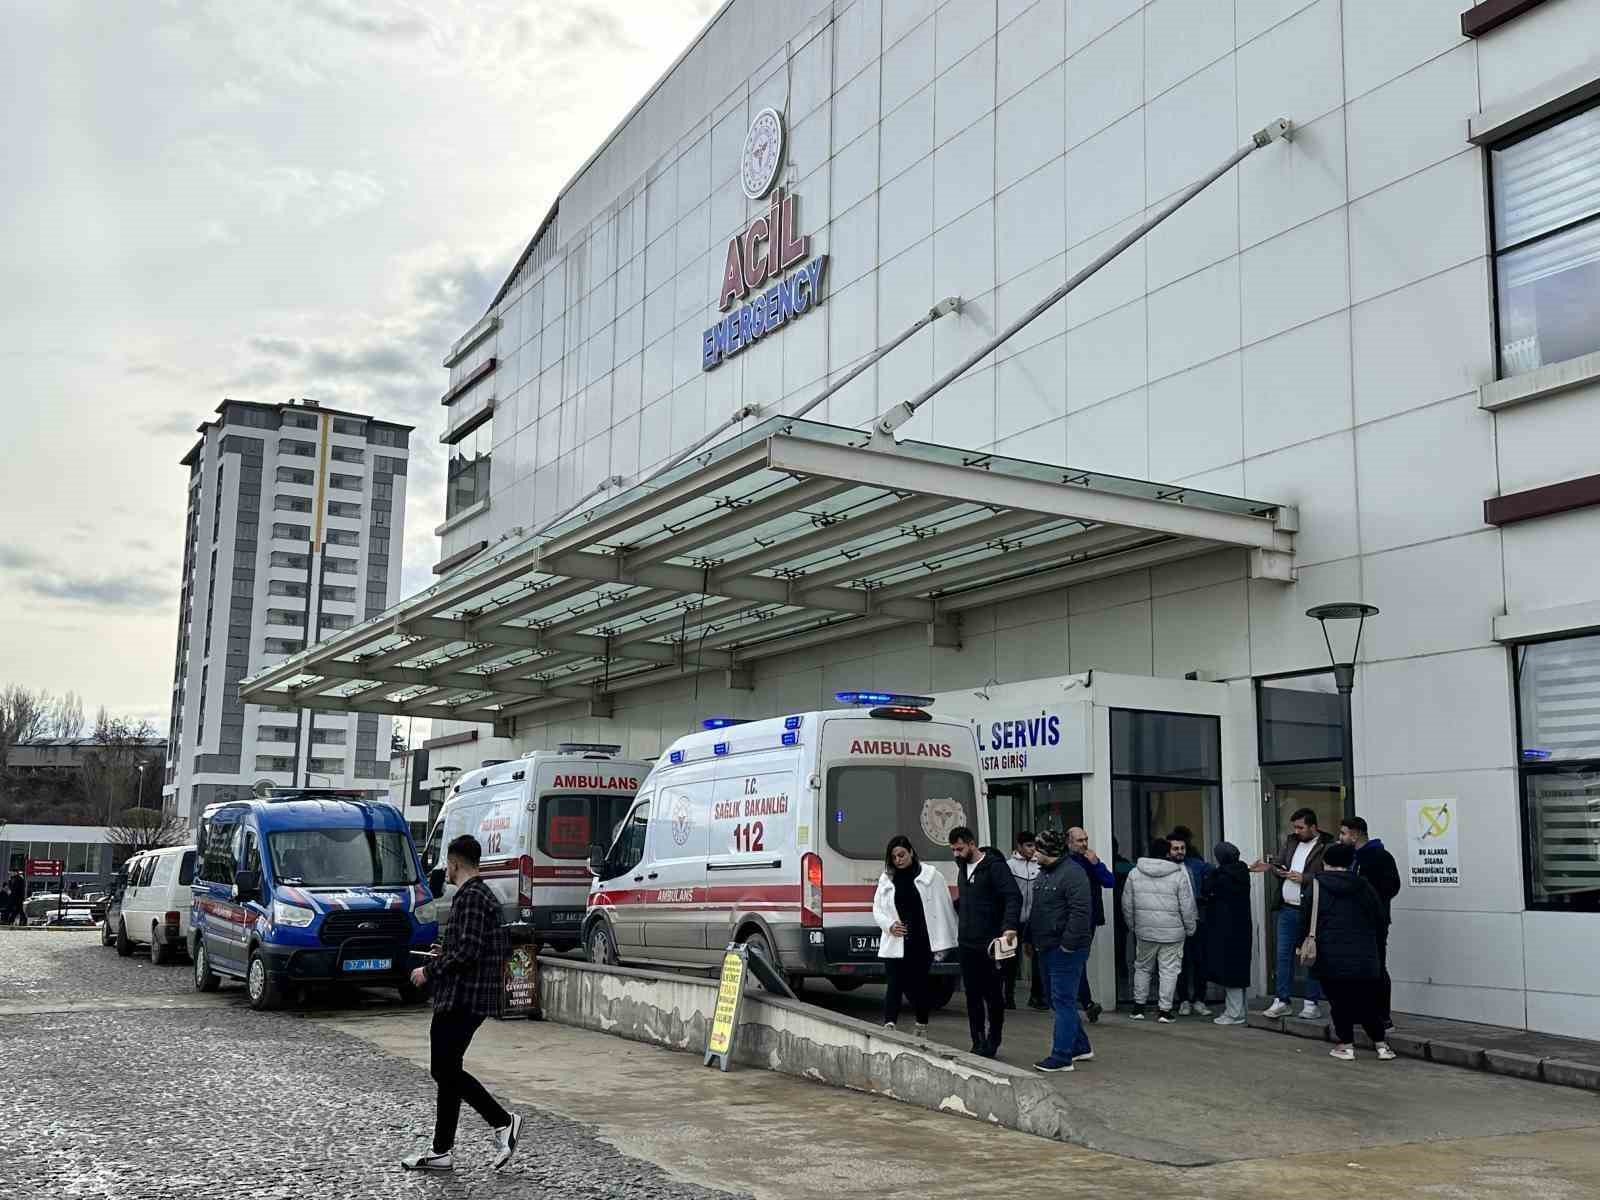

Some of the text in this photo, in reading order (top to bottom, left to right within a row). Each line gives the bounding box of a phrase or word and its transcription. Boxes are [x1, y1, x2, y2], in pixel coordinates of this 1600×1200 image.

[719, 186, 807, 312] ACİL
[703, 255, 827, 372] EMERGENCY
[992, 710, 1060, 751] SERVİS
[850, 740, 952, 758] AMBULANS
[1002, 750, 1027, 772] GİRİŞİ
[552, 775, 638, 790] AMBULANS
[744, 777, 758, 795] T.C.
[714, 792, 789, 820] SAĞLIK BAKANLIĞI
[487, 832, 502, 854] 112
[733, 821, 764, 852] 112
[328, 892, 400, 900] JANDARMA
[656, 887, 693, 902] AMBULANS
[857, 937, 867, 948] 37
